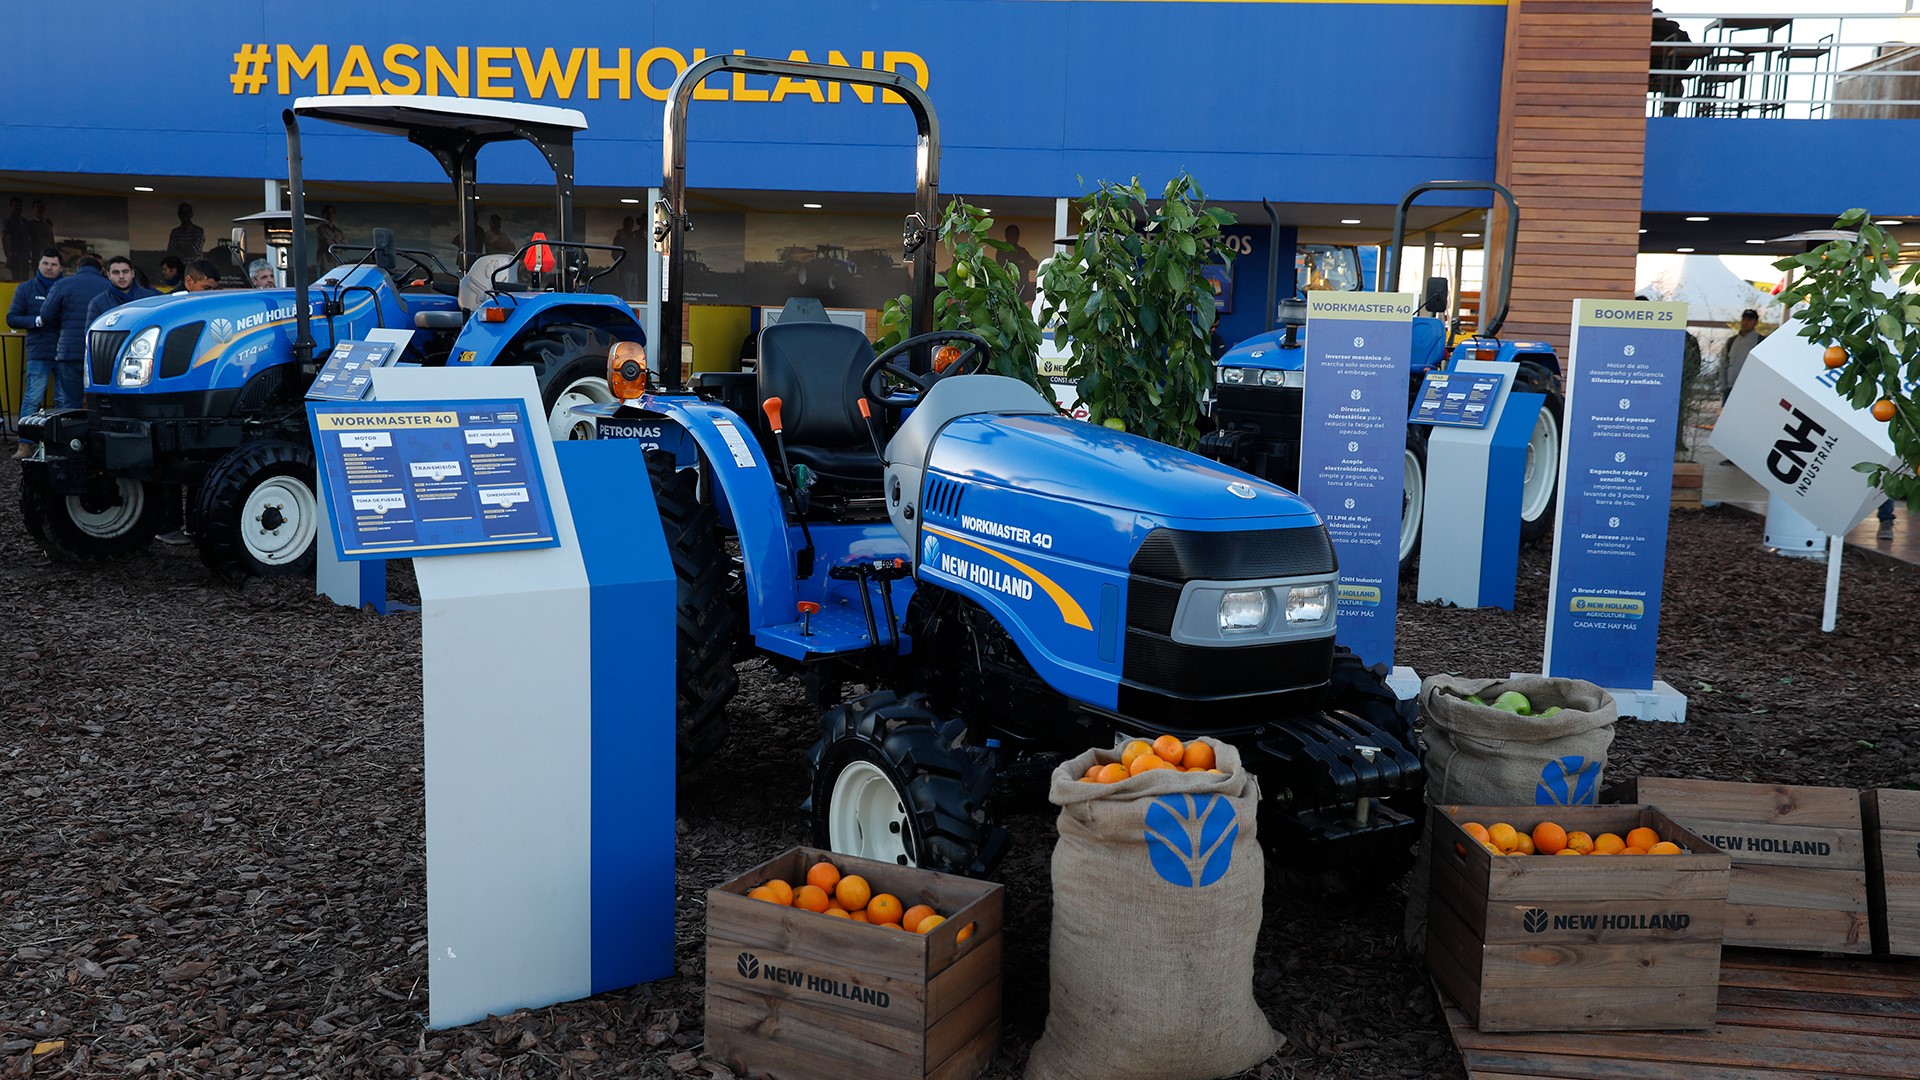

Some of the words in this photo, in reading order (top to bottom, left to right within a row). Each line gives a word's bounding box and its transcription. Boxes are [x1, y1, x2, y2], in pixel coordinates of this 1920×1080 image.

[230, 43, 930, 104] #MASNEWHOLLAND
[236, 312, 264, 331] NEW
[266, 304, 313, 322] HOLLAD
[1313, 302, 1393, 313] WORKMASTER
[1396, 305, 1410, 314] 40
[1595, 310, 1654, 321] BOOMER
[1658, 312, 1673, 321] 25
[331, 416, 432, 426] WORKMASTER
[436, 416, 452, 424] 40
[600, 424, 661, 438] PETRONAS
[1766, 408, 1826, 485] CNH
[1796, 435, 1838, 497] INDUSTRIAL
[961, 515, 1030, 544] WORKMASTER
[1032, 532, 1052, 549] 40
[942, 553, 968, 579] NEW
[970, 563, 1033, 601] HOLLAND
[1702, 835, 1743, 850] NEW
[1748, 838, 1830, 856] HOLLAND
[1553, 914, 1598, 930] NEW
[1602, 914, 1690, 930] HOLLAND
[764, 964, 803, 987] NEW
[807, 975, 890, 1008] HOLLAND
